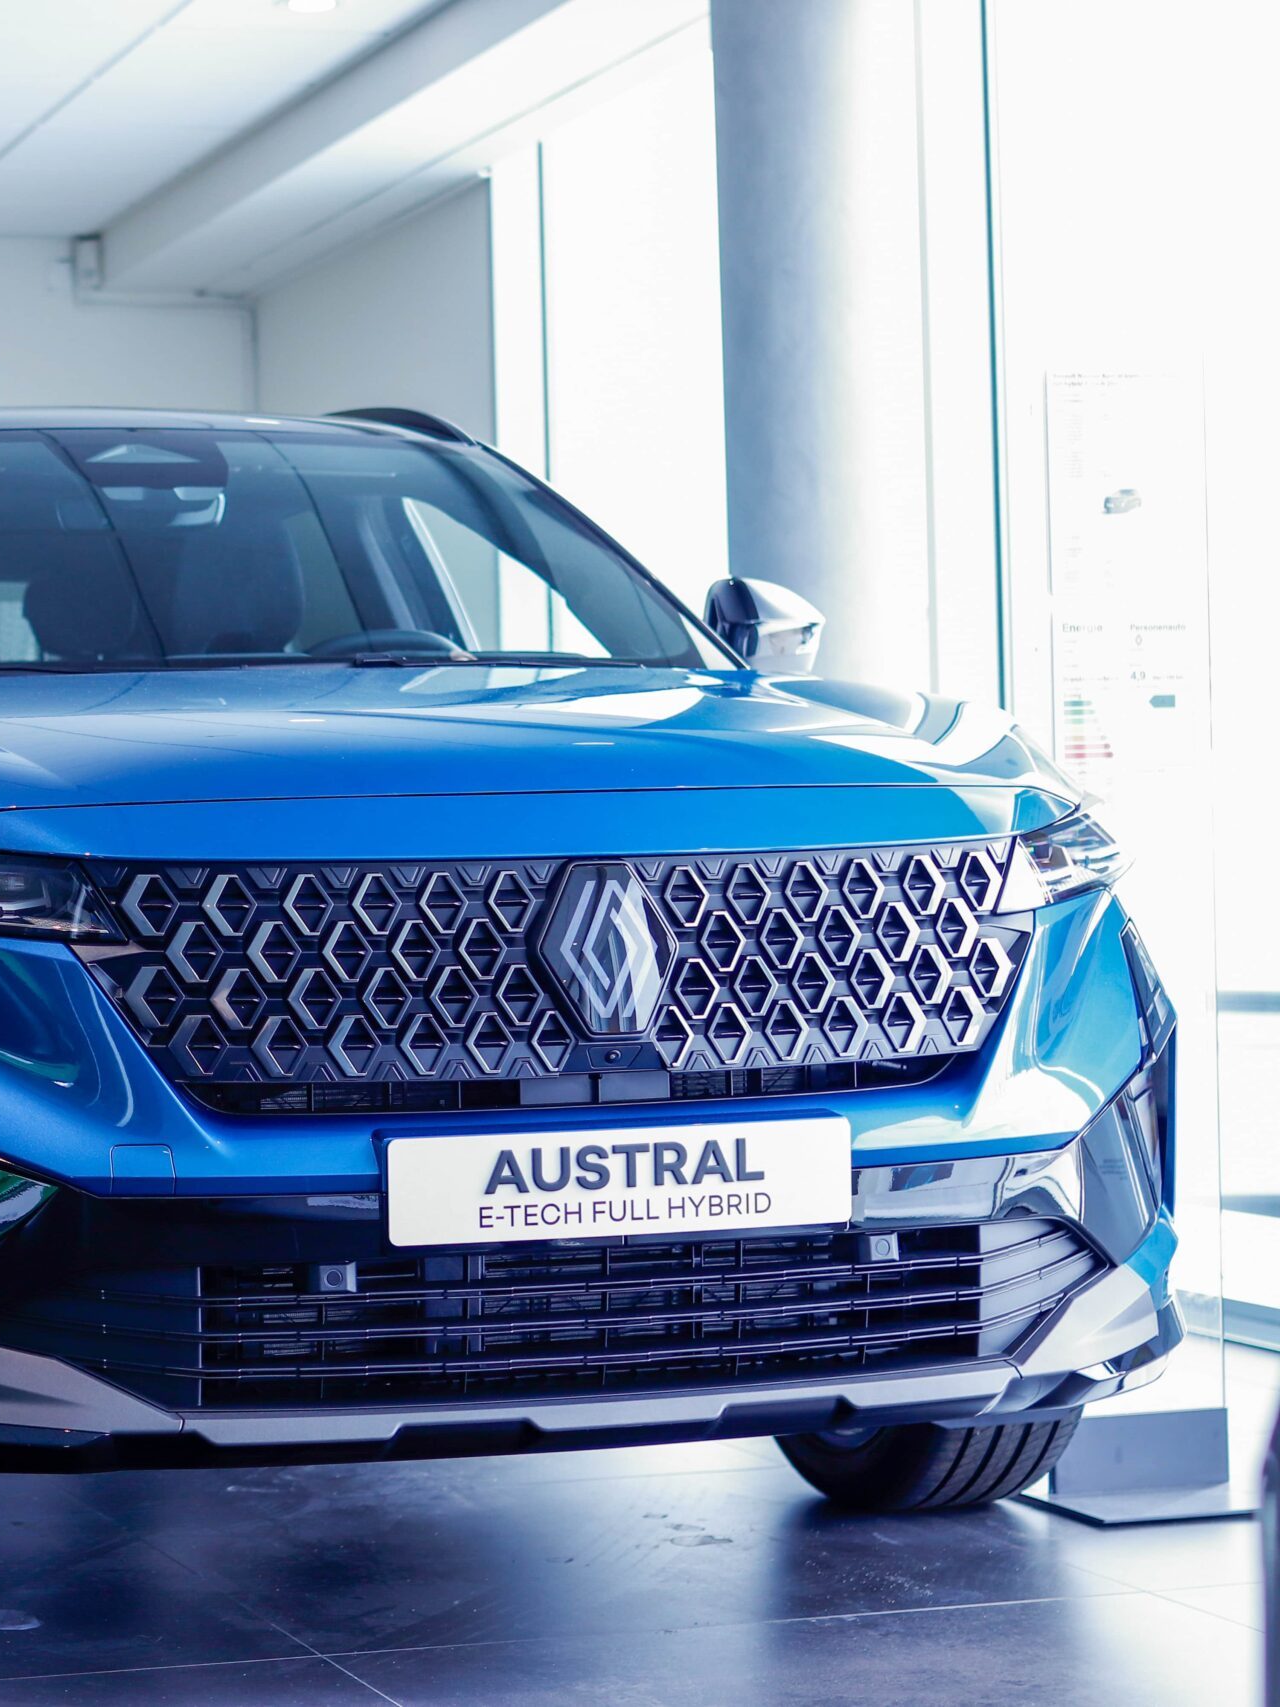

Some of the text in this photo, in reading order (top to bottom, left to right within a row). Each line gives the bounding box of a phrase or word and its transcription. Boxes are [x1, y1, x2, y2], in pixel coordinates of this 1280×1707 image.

[483, 1138, 765, 1195] AUSTRAL
[479, 1192, 772, 1228] E-TECH FULL HYBRID
